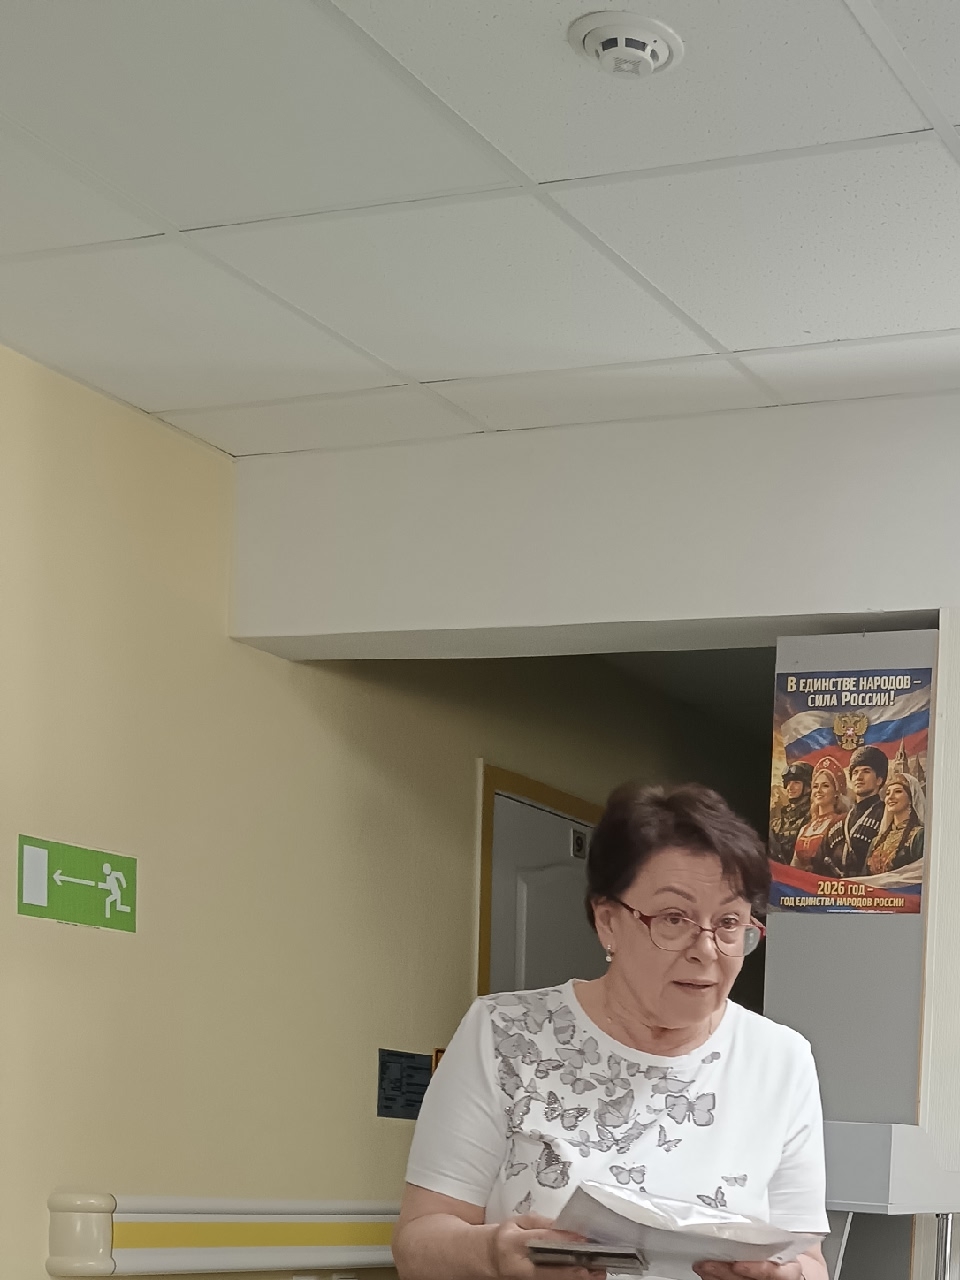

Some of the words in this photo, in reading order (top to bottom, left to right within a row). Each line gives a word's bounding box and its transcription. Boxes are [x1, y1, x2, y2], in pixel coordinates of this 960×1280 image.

[800, 677, 857, 692] ЕДИНСТВЕ
[860, 676, 911, 690] НАРОДОВ
[808, 693, 837, 707] СИЛА
[576, 836, 584, 852] 9
[818, 881, 844, 895] 2026
[848, 884, 865, 896] ГОД
[780, 897, 795, 906] ГОД
[796, 897, 835, 906] ЕДИНСТВА
[836, 897, 873, 907] НАРОДОВ
[874, 898, 904, 907] РОССИИ
